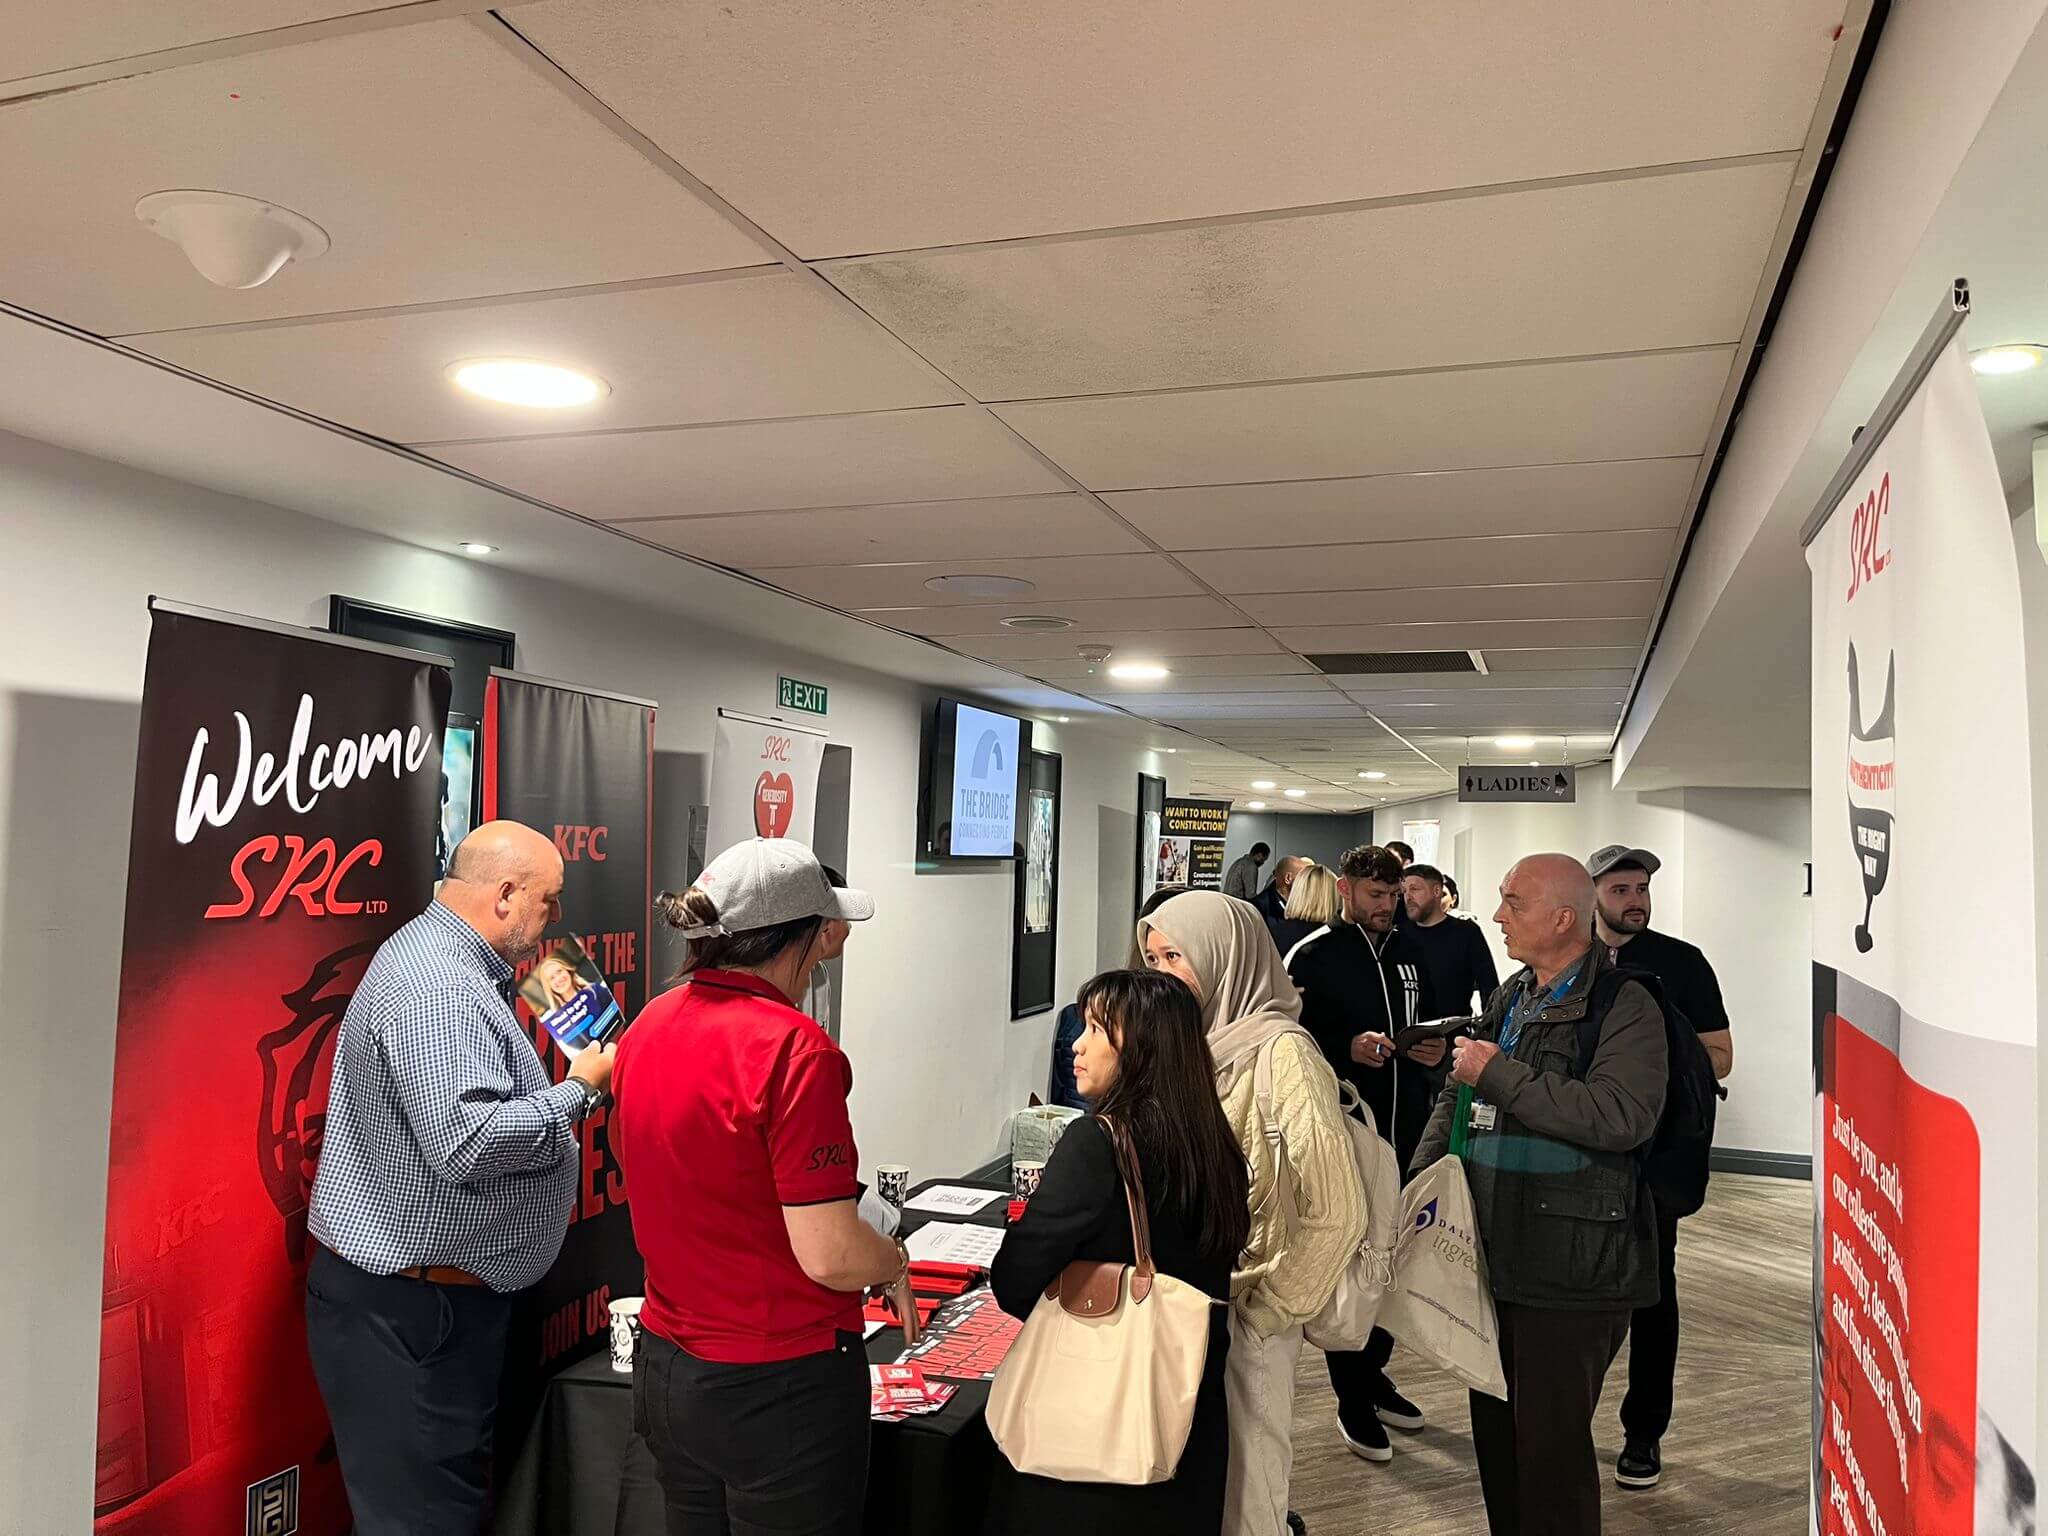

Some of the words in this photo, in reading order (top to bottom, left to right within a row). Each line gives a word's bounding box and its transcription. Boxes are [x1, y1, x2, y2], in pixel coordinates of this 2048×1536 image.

[1847, 471, 1889, 602] SRC
[794, 683, 825, 712] EXIT
[174, 692, 433, 845] Welcome
[761, 735, 790, 761] SRC
[961, 788, 978, 818] THE
[979, 790, 1010, 820] BRIDGE
[1477, 776, 1551, 792] LADIES
[1165, 806, 1188, 818] WANT
[1189, 807, 1200, 818] TO
[1200, 809, 1222, 820] WORK
[1169, 819, 1226, 832] CONSTRUCTION?
[553, 825, 609, 862] KFC
[203, 834, 383, 920] SRC
[366, 901, 388, 914] LTD
[603, 931, 636, 976] THE
[1404, 981, 1420, 990] KFC
[806, 1144, 848, 1172] SRC
[1832, 1103, 1850, 1151] Just
[1850, 1116, 1860, 1163] be
[1860, 1140, 1879, 1193] you,
[1880, 1161, 1896, 1208] and
[1832, 1173, 1848, 1210] our
[1848, 1188, 1887, 1265] collective
[1832, 1231, 1871, 1318] positivity,
[541, 1302, 580, 1364] JOIN
[586, 1284, 610, 1334] US
[1832, 1292, 1848, 1338] and
[1848, 1307, 1862, 1364] fun
[1862, 1336, 1886, 1408] shine
[1831, 1399, 1846, 1456] We
[1845, 1429, 1866, 1506] focus
[1865, 1489, 1877, 1536] on
